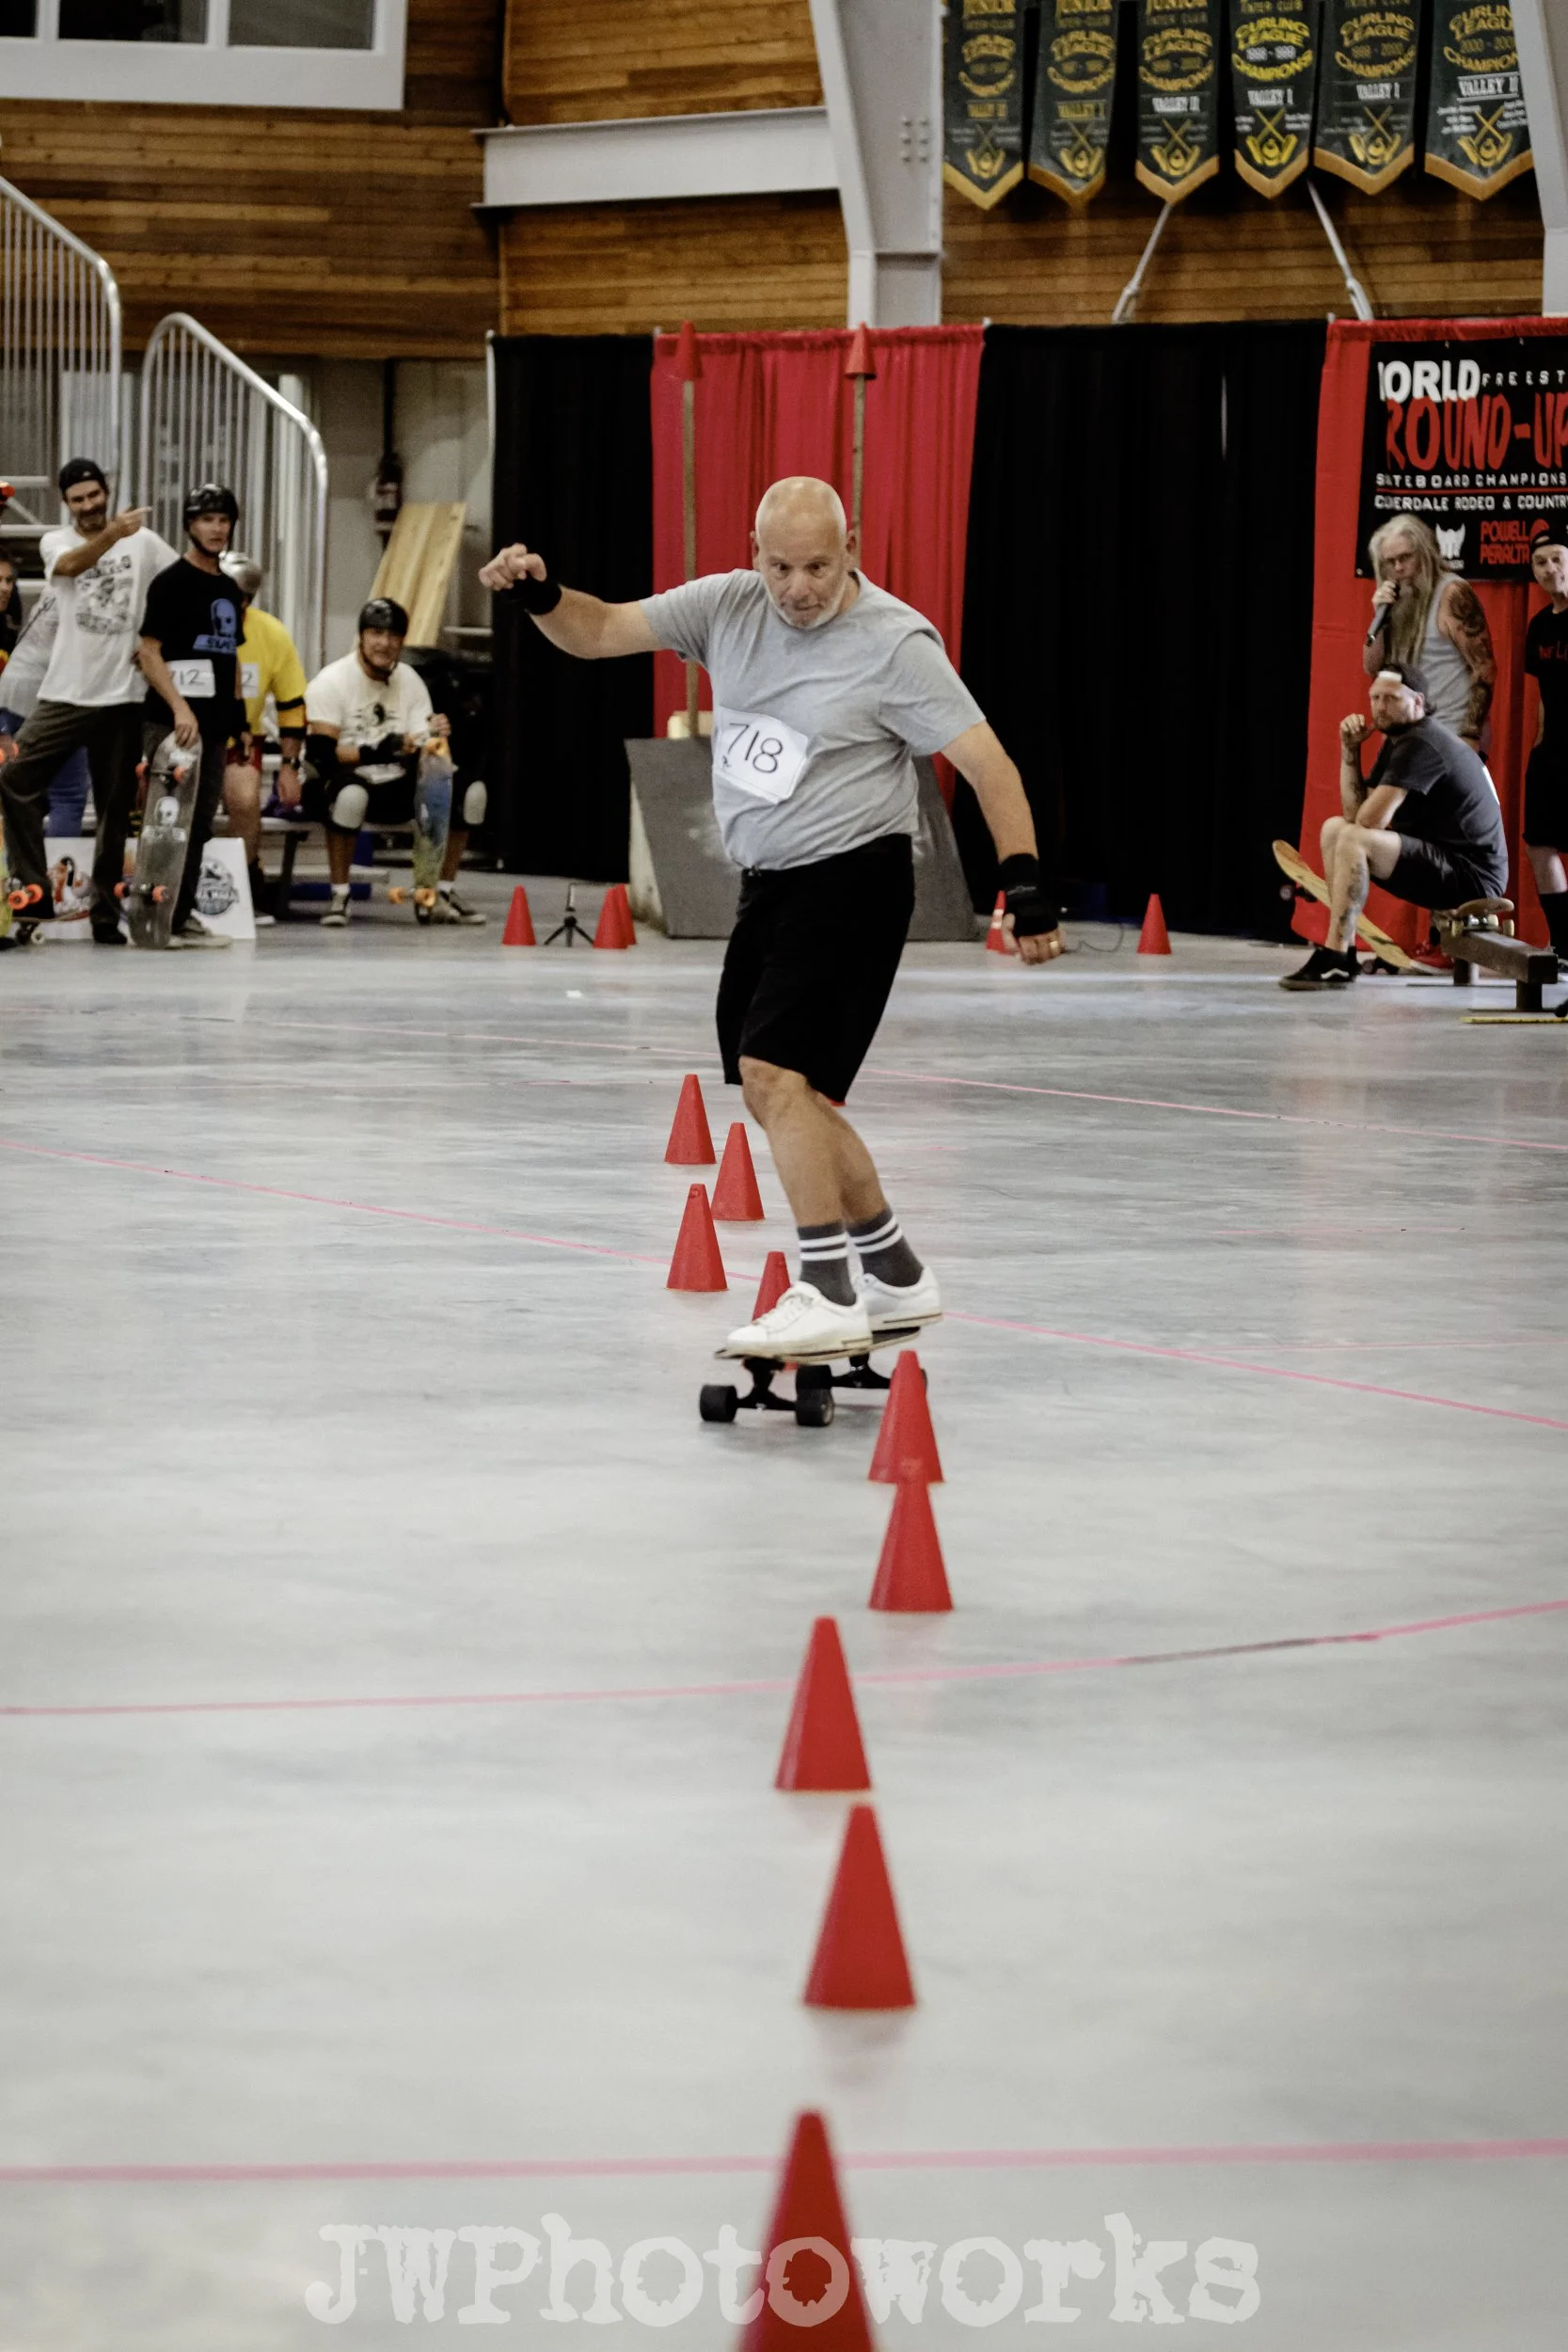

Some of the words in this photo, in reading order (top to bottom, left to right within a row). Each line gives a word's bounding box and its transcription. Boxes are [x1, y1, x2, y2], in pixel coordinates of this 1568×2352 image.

[1449, 5, 1513, 32] CURLIN
[1455, 15, 1513, 40] LEAGU
[1443, 46, 1518, 72] CHAMPION
[1458, 77, 1505, 97] VALLEY
[1480, 520, 1529, 542] POWELL
[1480, 543, 1530, 564] PERALTA
[728, 722, 784, 773] 718
